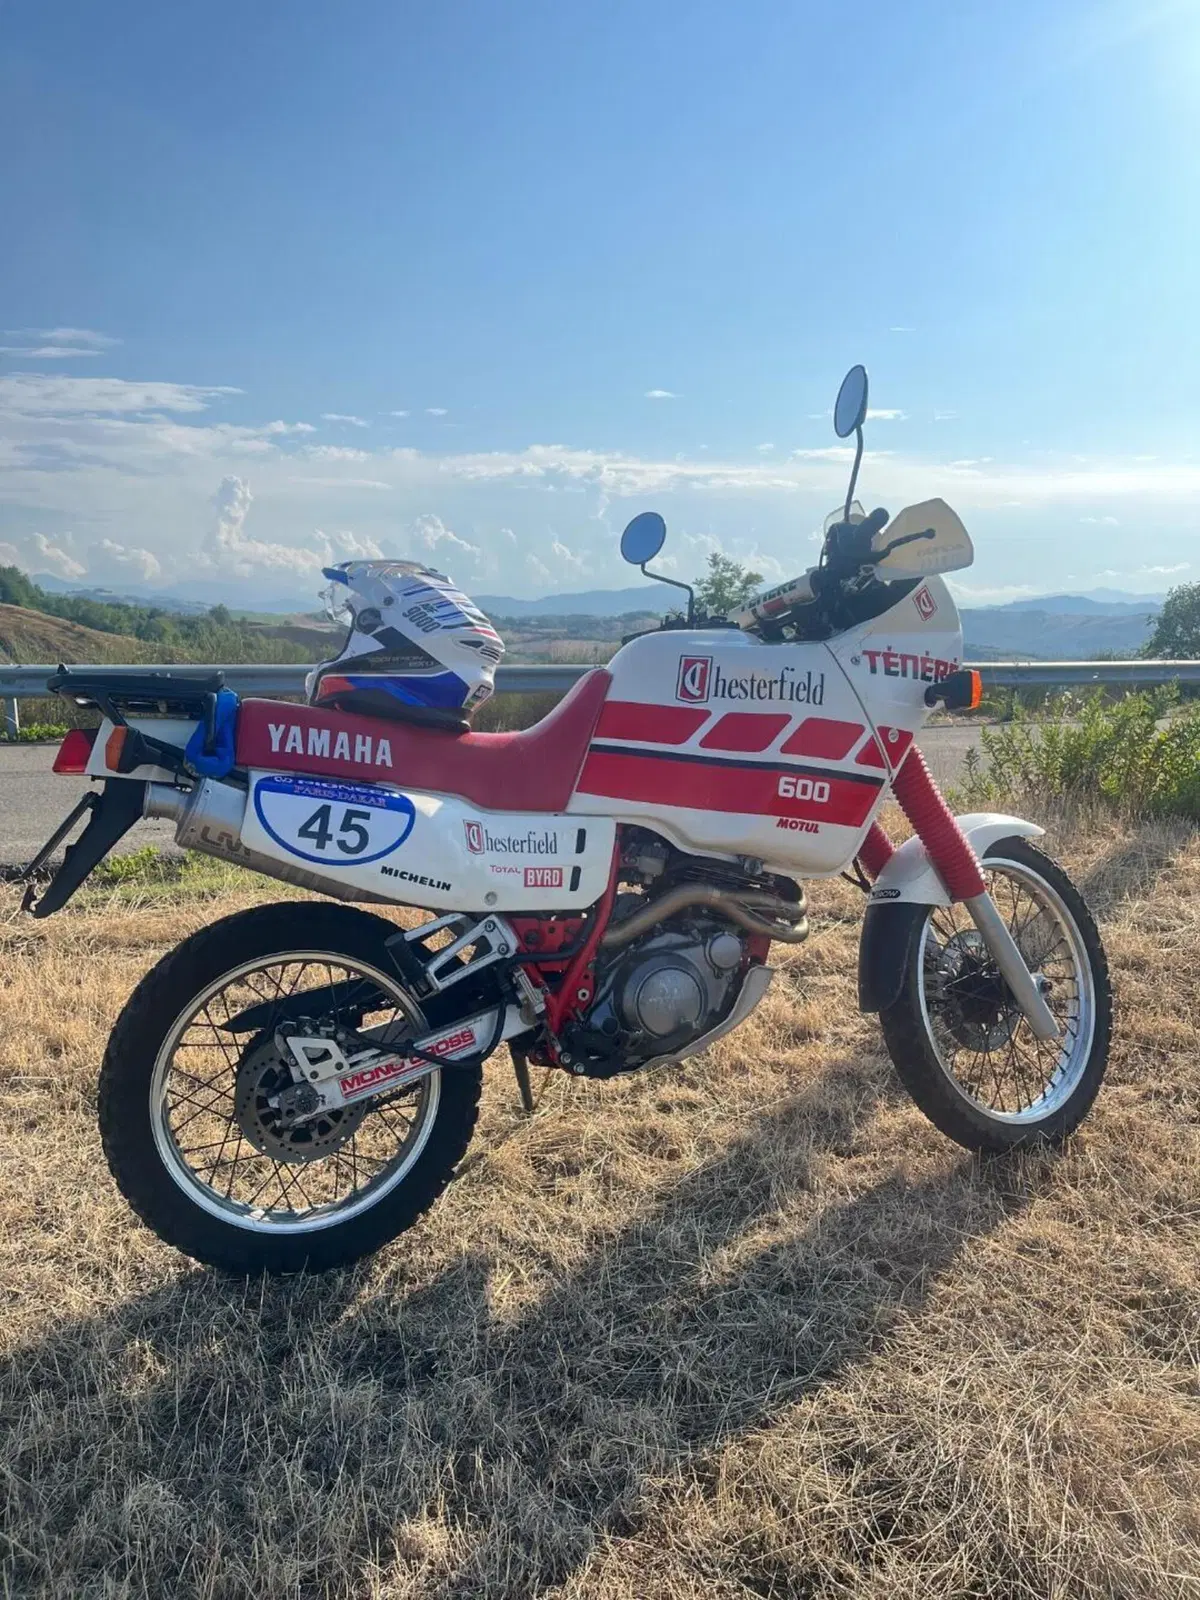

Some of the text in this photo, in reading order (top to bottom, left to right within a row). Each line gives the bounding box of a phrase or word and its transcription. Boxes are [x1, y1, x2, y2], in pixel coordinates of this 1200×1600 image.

[675, 655, 824, 705] Chesterfield
[268, 723, 393, 767] YAMAHA
[778, 776, 830, 803] 600
[297, 804, 371, 855] 45
[463, 820, 557, 855] Chesterfield
[776, 818, 819, 835] MOTUL
[381, 866, 452, 891] MICHELIN
[527, 868, 560, 886] BYRD
